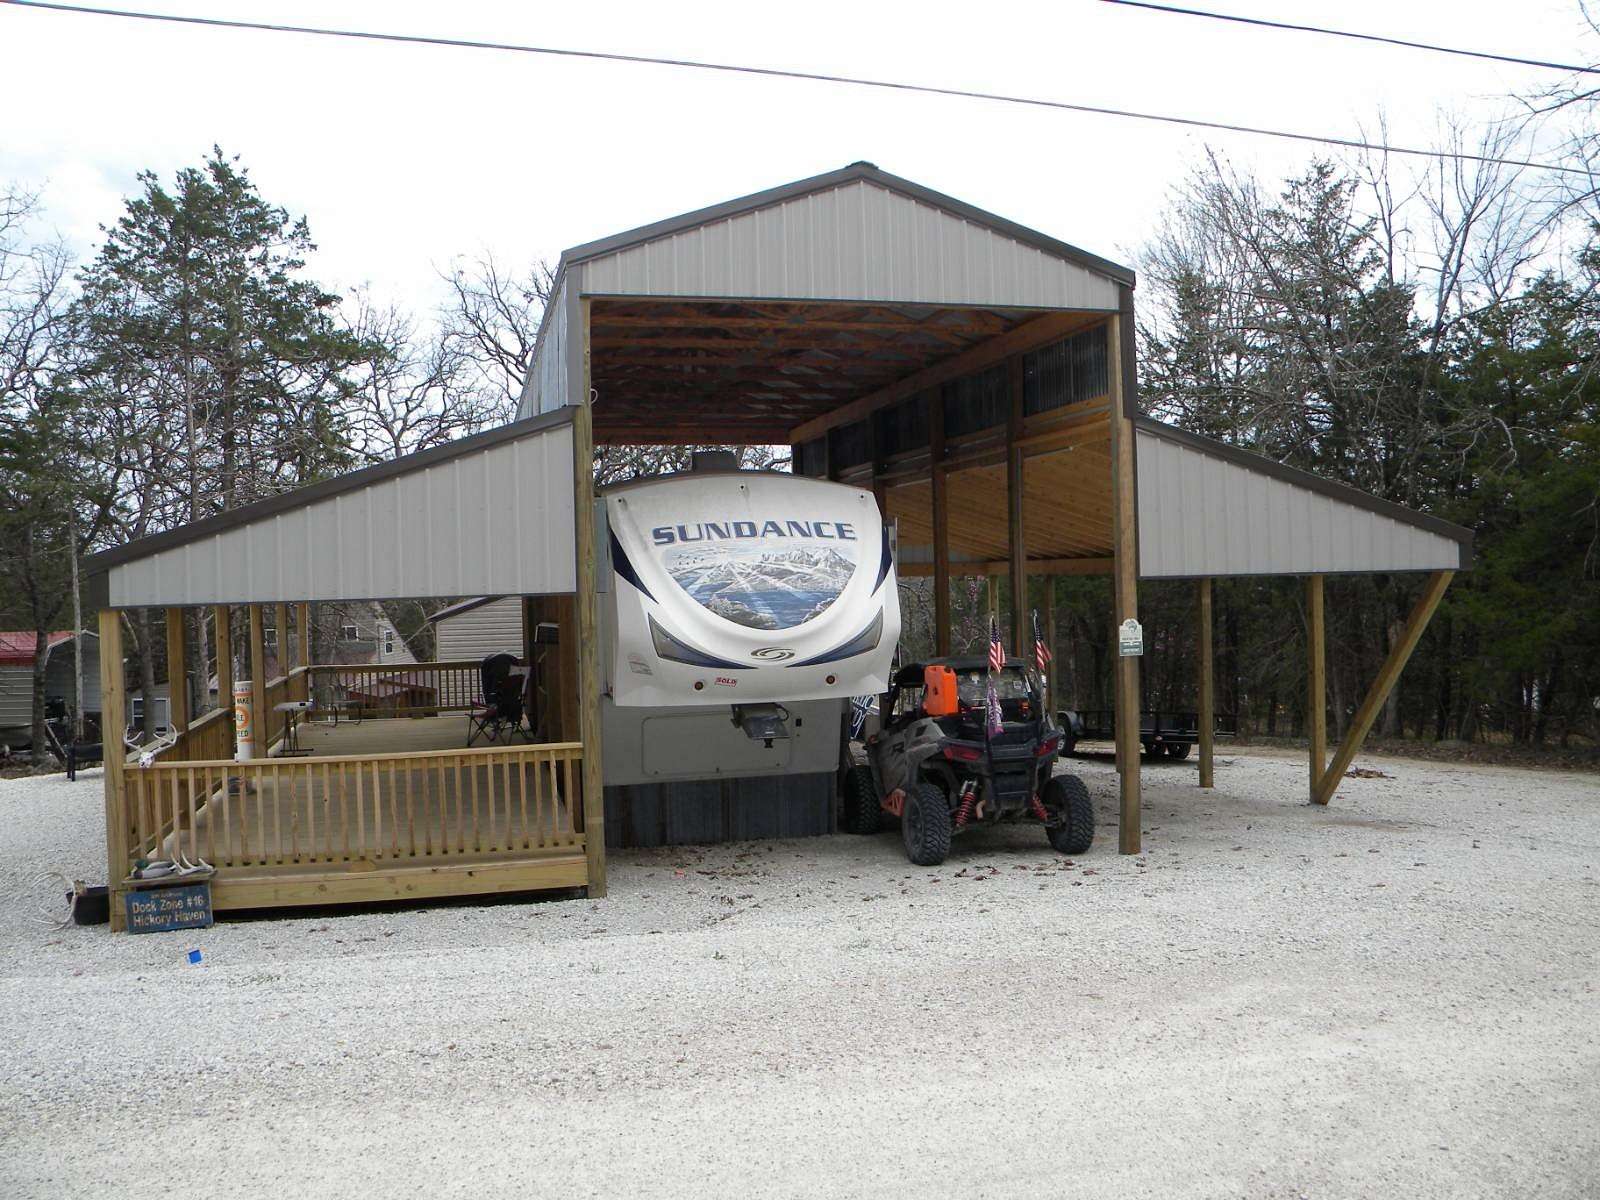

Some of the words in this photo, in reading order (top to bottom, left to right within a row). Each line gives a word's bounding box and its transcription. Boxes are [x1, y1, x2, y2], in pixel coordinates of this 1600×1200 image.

[652, 520, 857, 545] SUNDANCE
[160, 899, 183, 911] Zone
[187, 895, 203, 908] #16
[134, 914, 171, 927] Hickory
[175, 911, 205, 922] Haven
